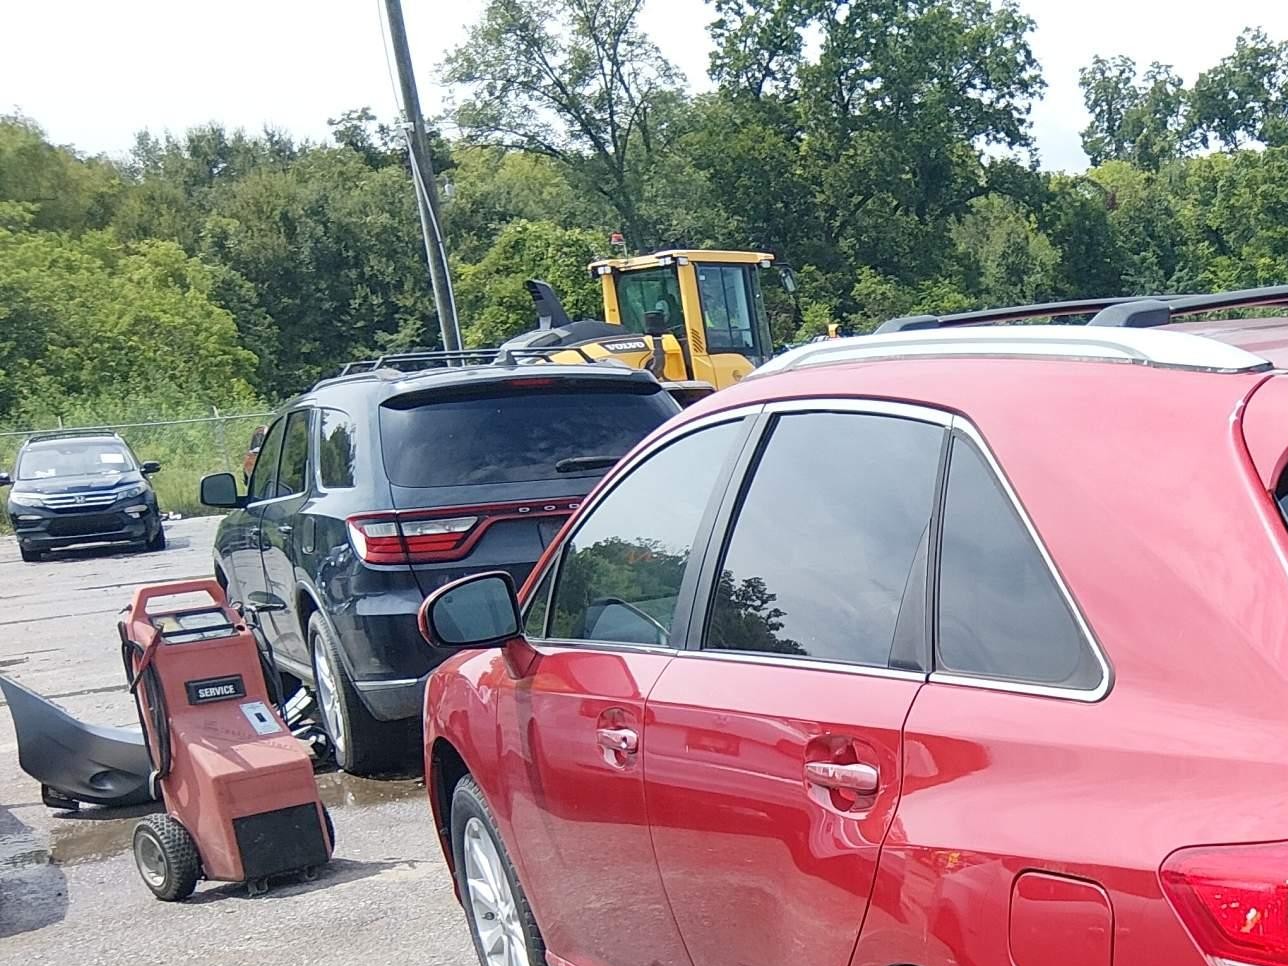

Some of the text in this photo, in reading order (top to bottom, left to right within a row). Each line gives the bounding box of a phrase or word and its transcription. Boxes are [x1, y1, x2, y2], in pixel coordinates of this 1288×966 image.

[604, 341, 645, 351] VOLVO
[518, 503, 581, 513] DOD
[198, 684, 236, 698] SERVICE
